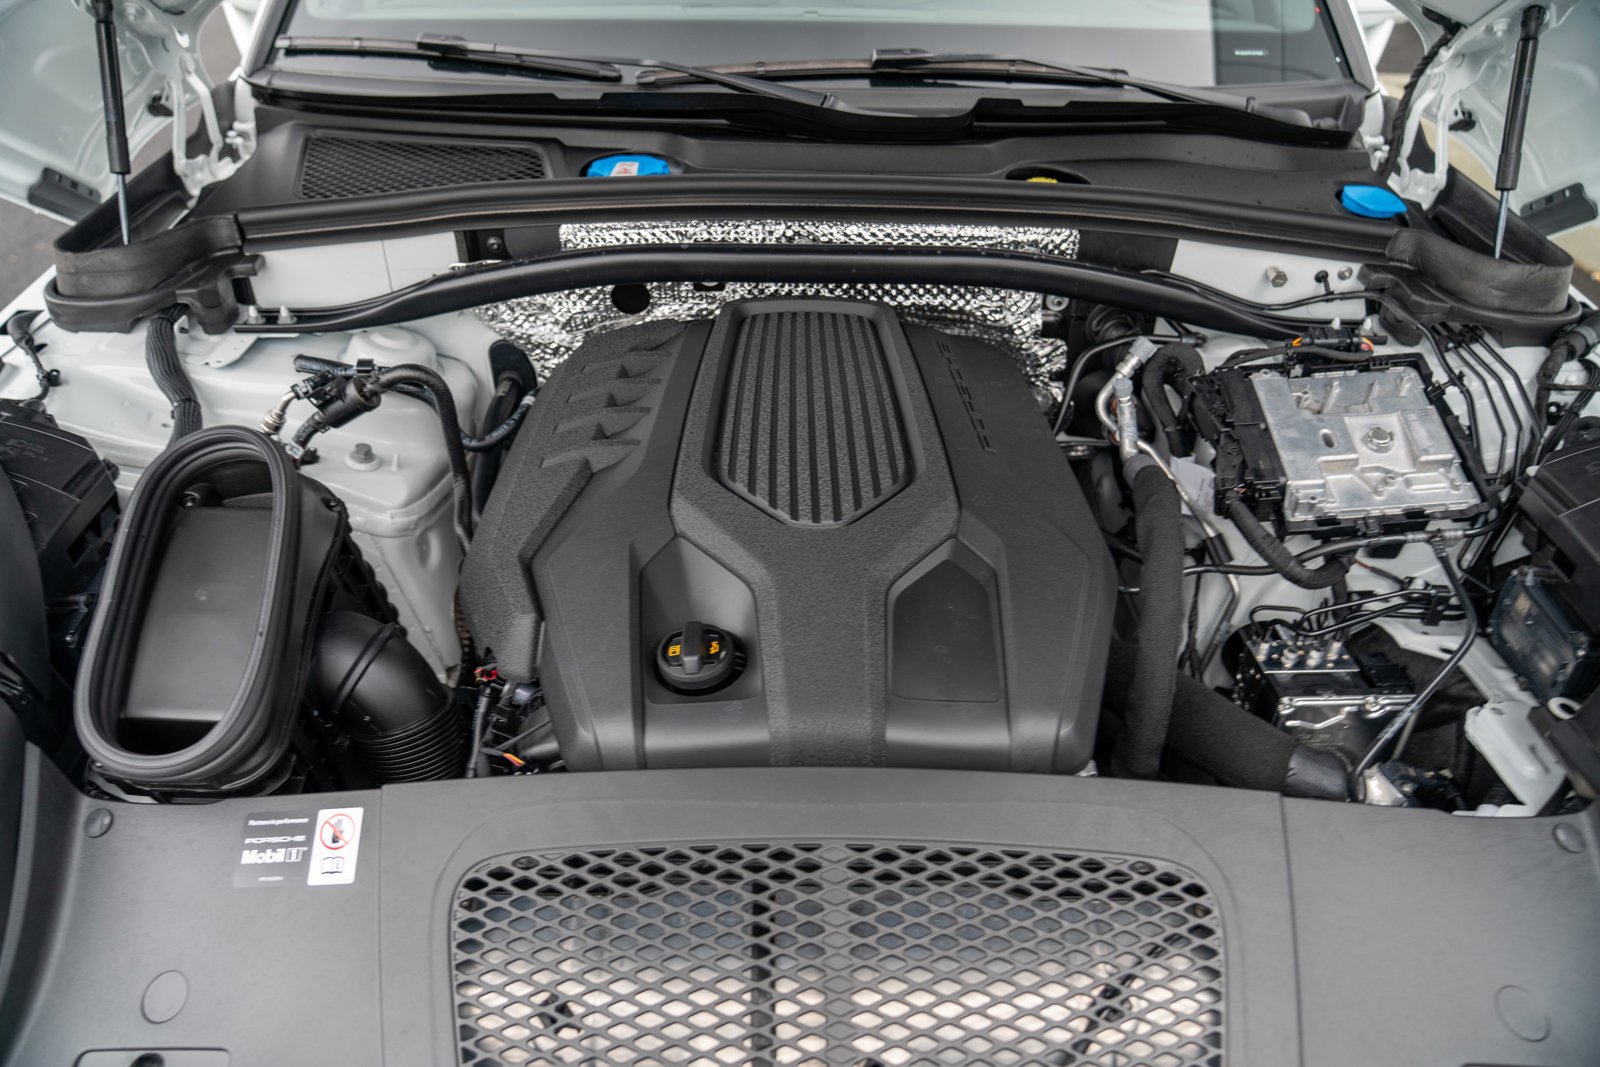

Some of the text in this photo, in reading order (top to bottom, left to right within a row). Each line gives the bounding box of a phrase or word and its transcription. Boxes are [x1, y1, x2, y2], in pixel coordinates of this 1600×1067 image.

[936, 341, 997, 454] PORSCHE
[244, 835, 306, 844] PORSCHE
[241, 848, 286, 864] Mobil
